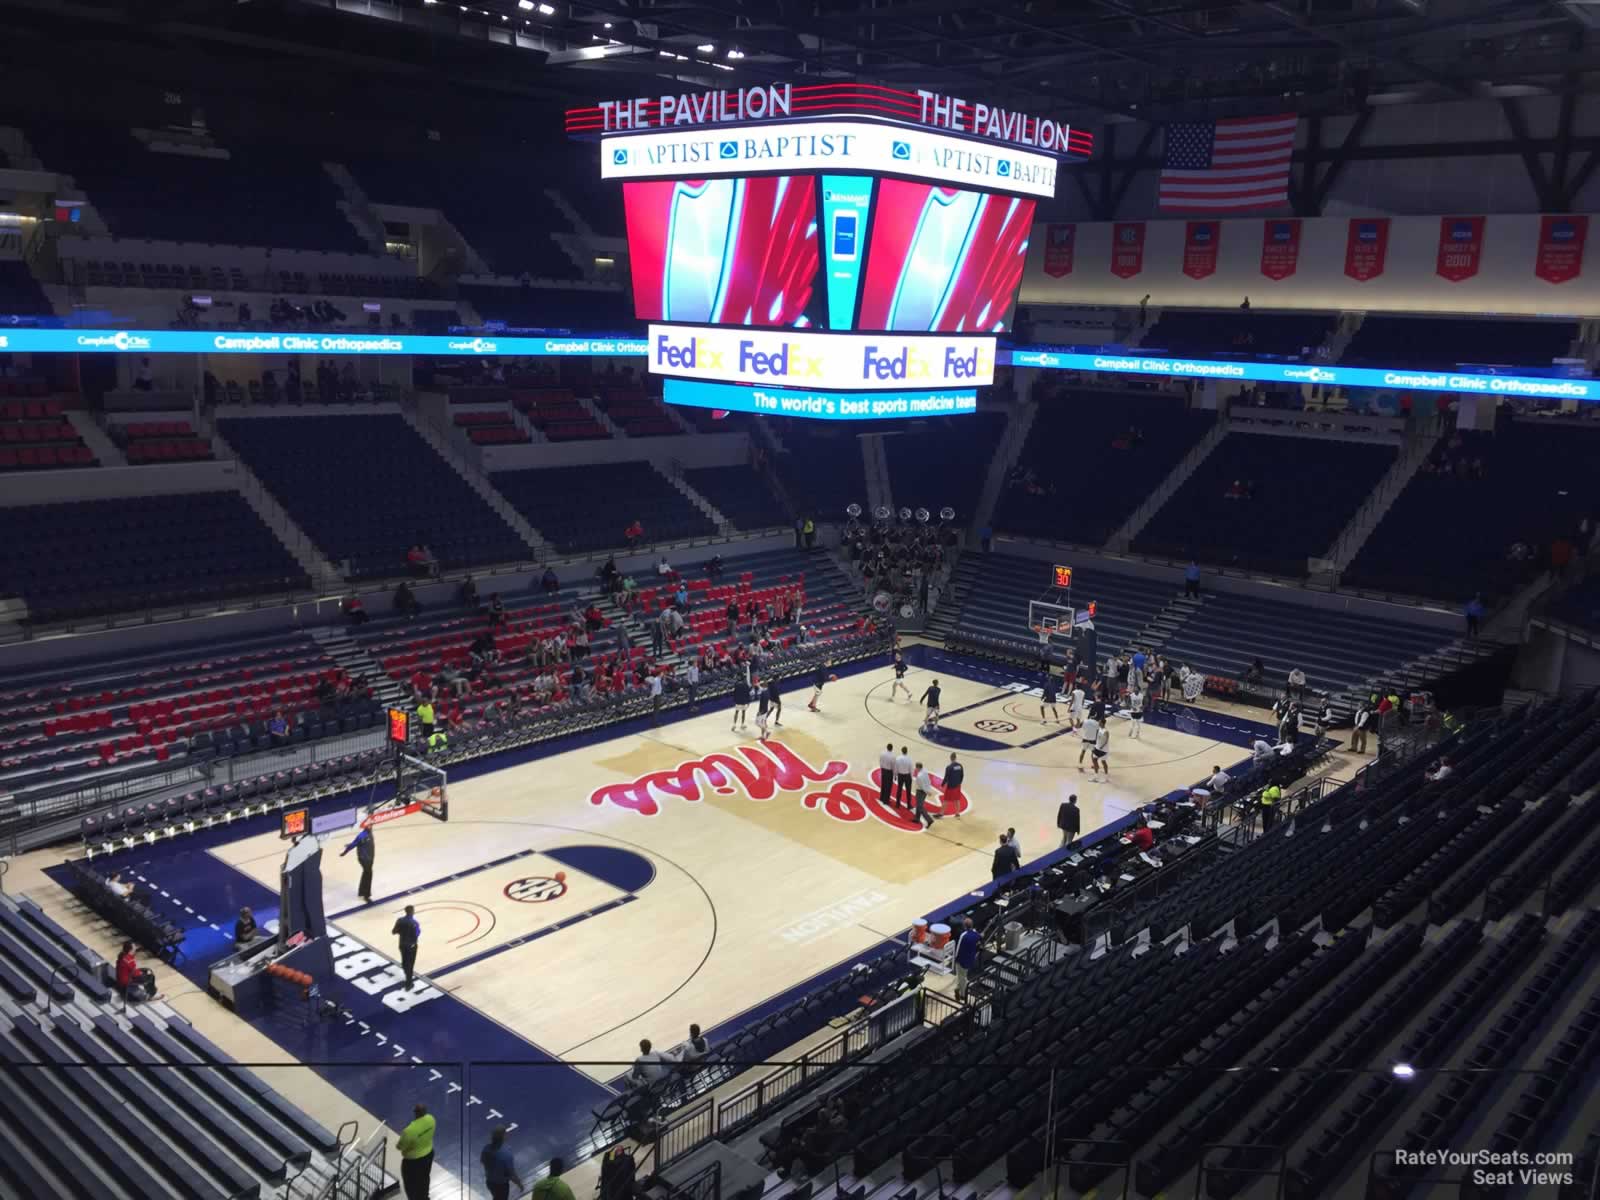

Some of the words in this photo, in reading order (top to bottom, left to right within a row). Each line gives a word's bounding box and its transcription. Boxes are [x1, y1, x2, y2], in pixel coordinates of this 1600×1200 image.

[599, 98, 649, 131] THE
[660, 83, 793, 127] PAVILION
[917, 89, 967, 131] THE
[973, 103, 1071, 152] PAVILION
[633, 142, 714, 165] PTIST
[745, 133, 857, 159] BAPTIST
[917, 146, 993, 175] PTIST
[214, 335, 279, 350] Campbell
[283, 336, 318, 350] Clinic
[321, 337, 402, 352] Orthopaedics
[545, 341, 588, 354] Campbell
[591, 341, 615, 353] Clinic
[617, 342, 648, 354] Orthop
[657, 335, 723, 368] FedEx
[738, 340, 824, 378] FedEx
[863, 345, 931, 380] FedEx
[1094, 357, 1140, 371] Campbell
[1142, 359, 1170, 372] Clinic
[1173, 361, 1244, 376] Orthopaedics
[1384, 373, 1446, 388] Campbell
[1450, 376, 1486, 390] Clinic
[1491, 380, 1587, 395] Orthopaedics
[753, 391, 777, 409] The
[781, 396, 834, 413] world's
[840, 398, 869, 414] best
[872, 396, 907, 415] sports
[910, 396, 954, 412] medicine
[590, 738, 849, 817] Miss
[804, 767, 969, 832] Ole
